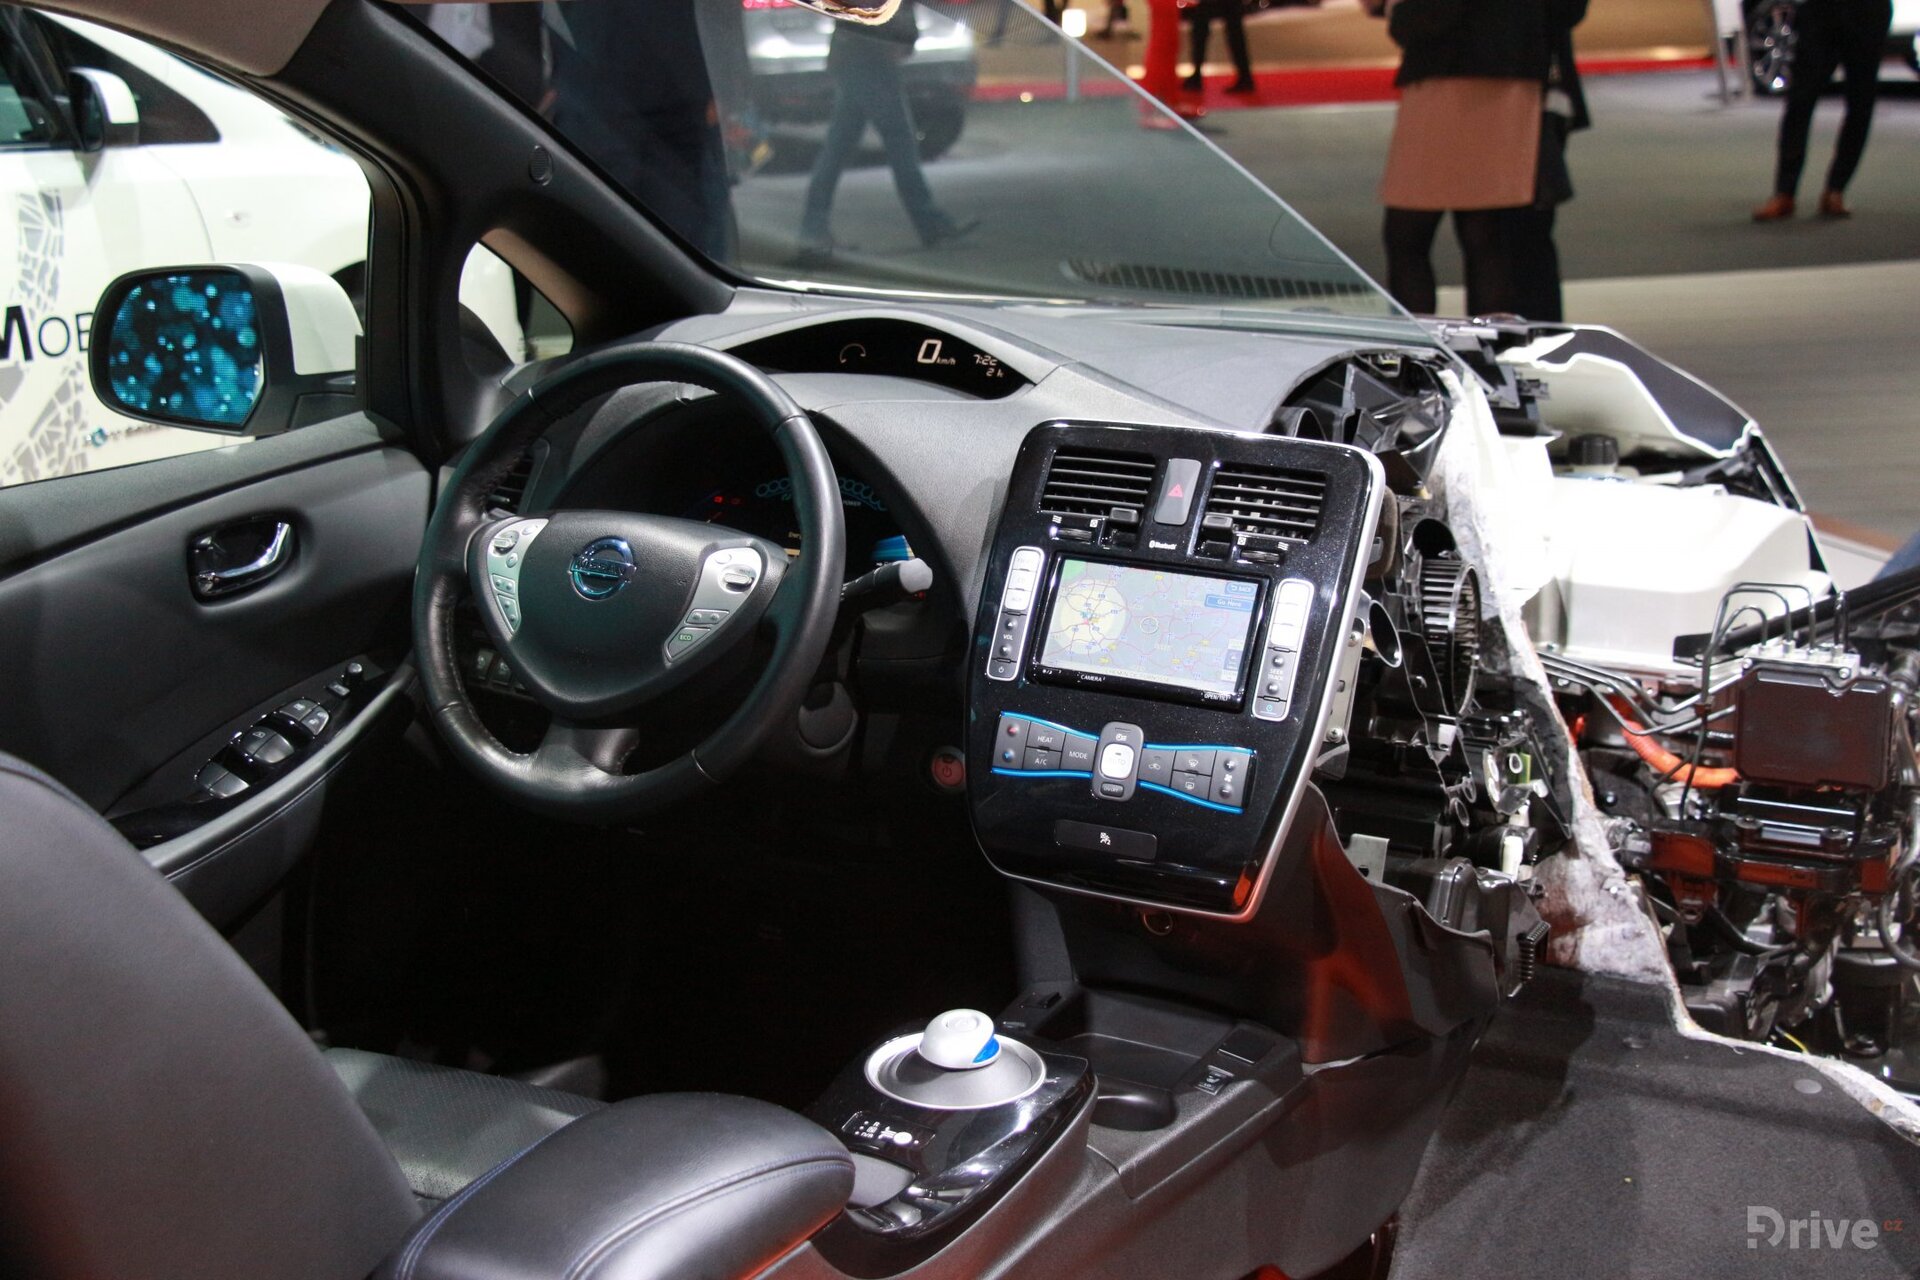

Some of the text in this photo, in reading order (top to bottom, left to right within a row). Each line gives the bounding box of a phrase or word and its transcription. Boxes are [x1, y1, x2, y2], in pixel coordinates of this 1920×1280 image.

[917, 339, 956, 366] 0 km/h
[1003, 633, 1013, 641] VOL
[1080, 674, 1102, 682] CAMERA
[1037, 735, 1053, 743] HEAT
[1068, 750, 1088, 760] MODE
[1034, 757, 1047, 766] A/C
